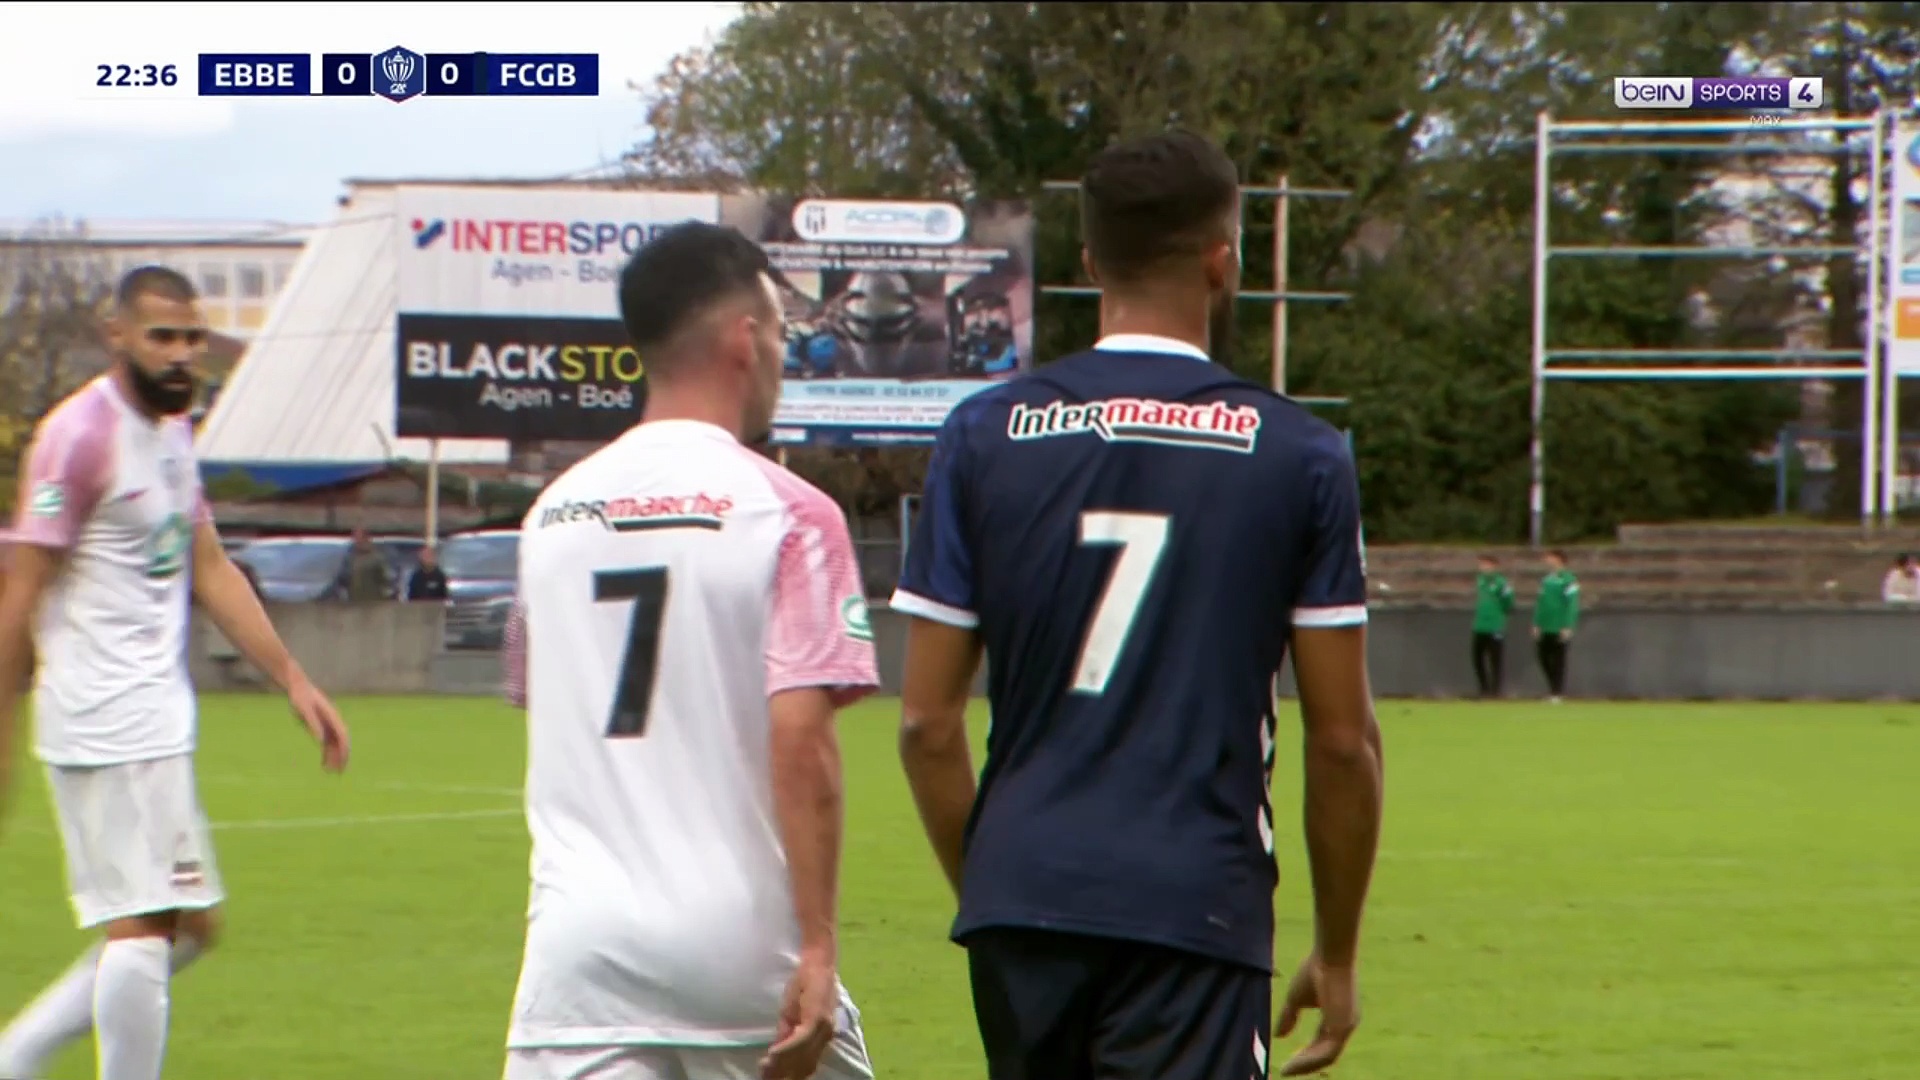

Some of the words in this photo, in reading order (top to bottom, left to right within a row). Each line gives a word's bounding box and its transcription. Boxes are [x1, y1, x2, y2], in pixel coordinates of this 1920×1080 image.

[491, 260, 553, 286] Agen
[407, 343, 644, 382] BLACKSTO
[479, 384, 553, 410] Agen
[578, 385, 634, 408] Boé
[1073, 512, 1170, 693] 7
[592, 566, 668, 737] 7
